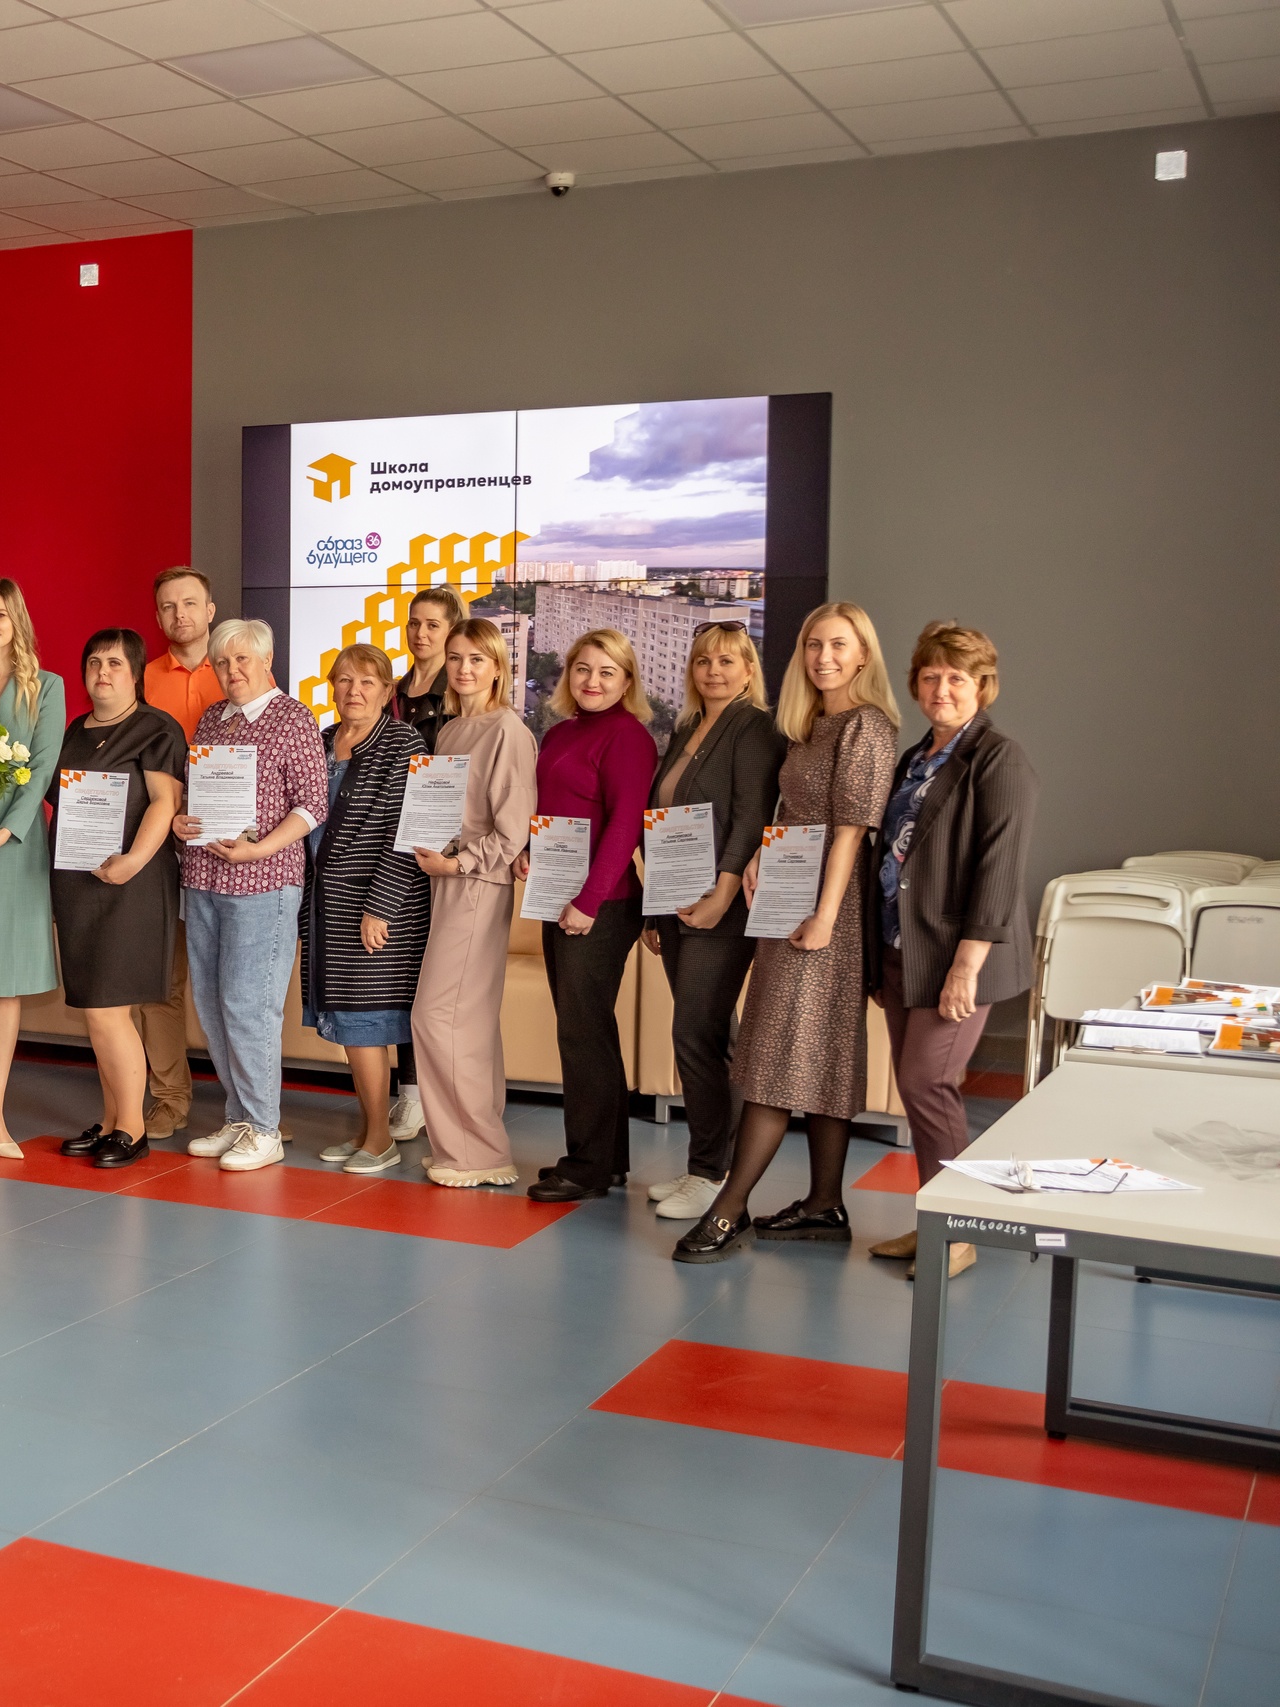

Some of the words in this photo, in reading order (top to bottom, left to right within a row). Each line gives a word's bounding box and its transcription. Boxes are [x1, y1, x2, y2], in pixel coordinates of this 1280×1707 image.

[370, 460, 429, 475] Школа
[370, 475, 532, 494] домоуправленцев
[316, 535, 363, 555] образ
[306, 548, 378, 569] будущего
